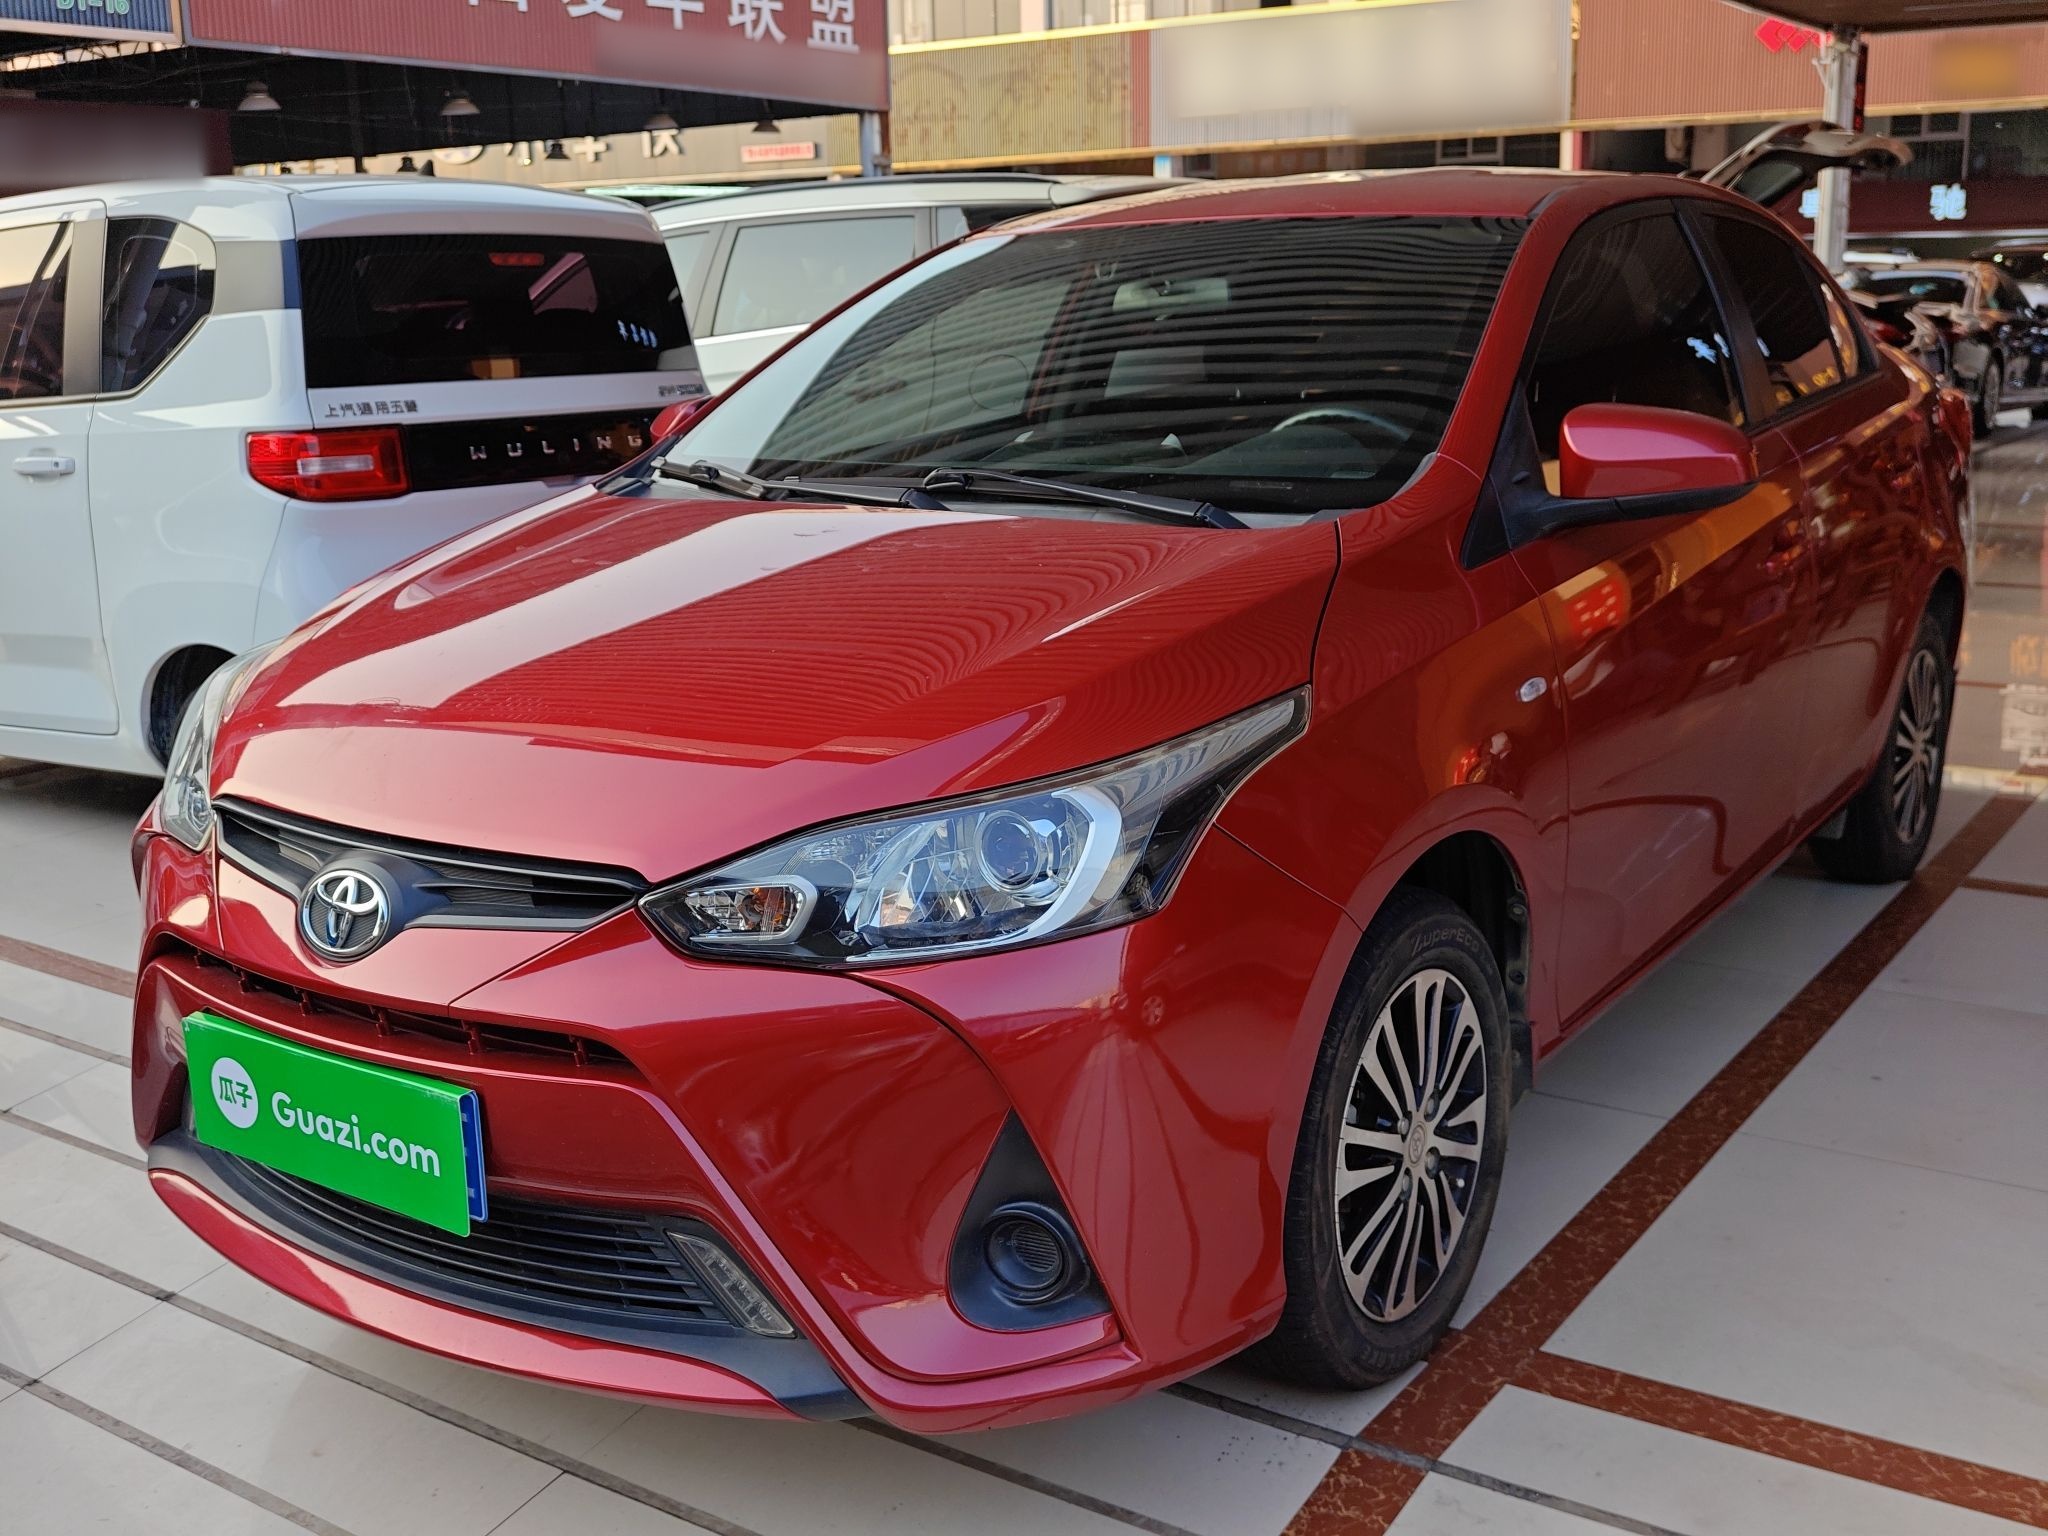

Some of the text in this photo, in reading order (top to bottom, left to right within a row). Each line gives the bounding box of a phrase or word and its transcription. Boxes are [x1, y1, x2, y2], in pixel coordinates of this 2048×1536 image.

[469, 434, 643, 461] WULING
[219, 1075, 252, 1109] 瓜子
[271, 1091, 441, 1178] Guazi.com
